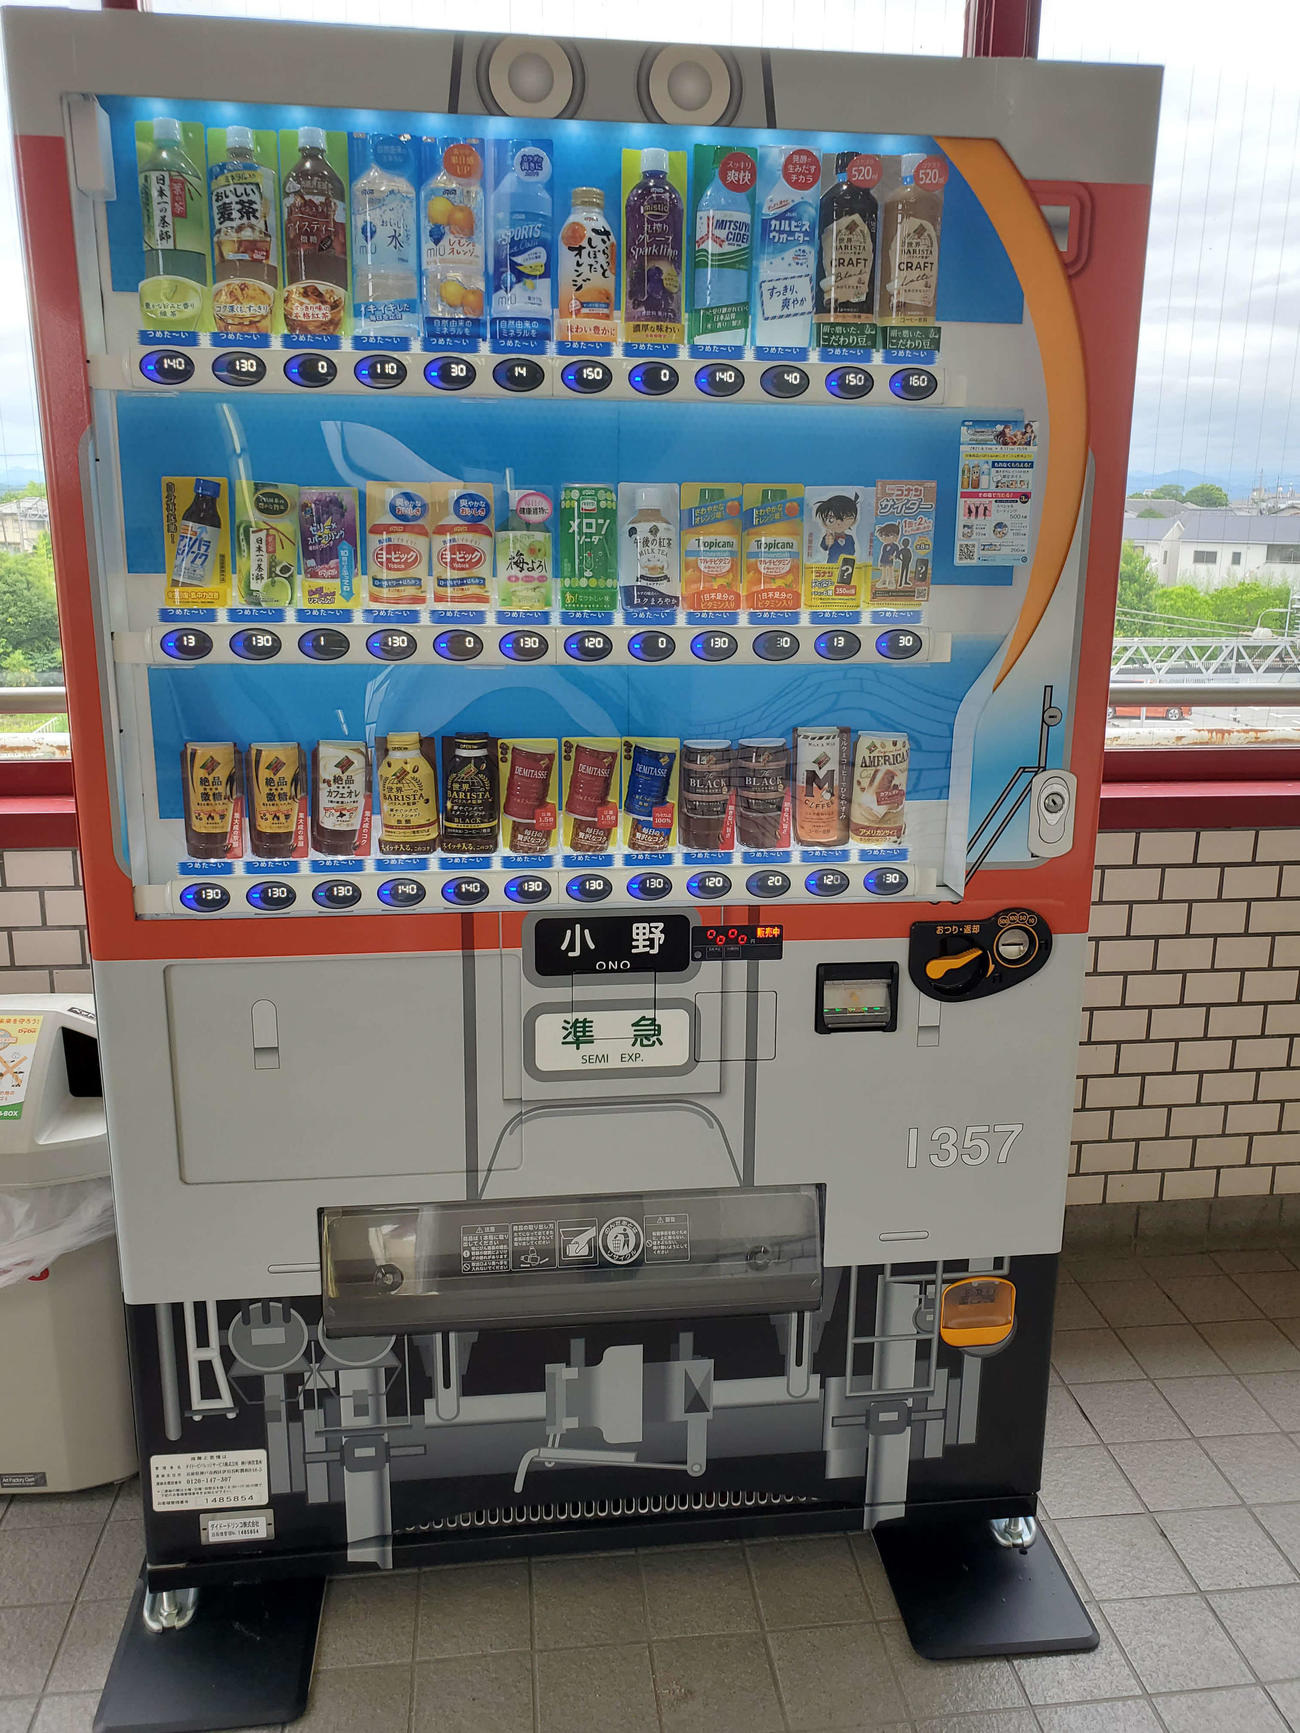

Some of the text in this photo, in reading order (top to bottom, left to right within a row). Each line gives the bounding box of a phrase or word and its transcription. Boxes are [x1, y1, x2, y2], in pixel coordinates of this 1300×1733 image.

[787, 164, 816, 174] 生みだす
[726, 170, 751, 185] 爽快
[791, 174, 813, 183] チカラ
[215, 187, 256, 203] おいしい
[156, 174, 171, 244] 日本一の茶師
[216, 199, 259, 225] 麦茶
[287, 220, 335, 235] アイスティー
[770, 219, 810, 232] カルピス
[387, 229, 404, 250] 水
[769, 231, 810, 244] ウォーター
[586, 236, 601, 273] しぼった
[591, 226, 612, 279] さらっと
[567, 244, 592, 292] オレンジ
[830, 258, 869, 269] CRAFT
[897, 261, 935, 272] CRAFT
[780, 297, 807, 312] 爽やか
[433, 319, 472, 328] 自然由来の
[499, 320, 539, 330] 自然由来の
[632, 324, 680, 334] 濃厚な味わい
[434, 329, 471, 337] ミネラルを
[501, 330, 537, 338] ミネラルを
[566, 325, 616, 337] 味わい豊かに
[163, 358, 184, 369] 140
[235, 360, 256, 371] 130
[317, 361, 327, 373] 0
[450, 365, 466, 376] 30
[514, 367, 526, 376] 14
[582, 368, 602, 379] 150
[660, 370, 669, 381] 0
[715, 371, 734, 382] 140
[783, 373, 799, 384] 40
[845, 374, 864, 385] 150
[909, 376, 927, 386] 160
[894, 486, 922, 498] コナン
[395, 507, 421, 517] おいしさ
[459, 507, 486, 516] おいしさ
[879, 497, 935, 516] サイダー
[568, 518, 611, 535] メロン
[633, 535, 672, 549] 午後の紅茶
[255, 536, 265, 584] 日本一の茶師
[377, 549, 417, 564] ヨービック
[442, 550, 481, 564] ヨービック
[698, 557, 730, 567] マルチビタミン
[758, 559, 791, 568] マルチビタミン
[814, 569, 834, 578] コナン
[633, 596, 678, 605] コクまろやか
[700, 592, 735, 601] 1日不足分の
[759, 591, 793, 600] 1日不足分の
[701, 600, 735, 610] ビタミン入り
[759, 600, 793, 609] ビタミン入り
[183, 636, 195, 646] 13
[252, 636, 272, 646] 130
[320, 637, 324, 645] 1
[387, 636, 407, 647] 130
[465, 637, 473, 647] 0
[520, 638, 538, 648] 130
[584, 638, 603, 648] 120
[658, 638, 666, 648] 0
[710, 638, 728, 648] 130
[833, 637, 844, 647] 13
[898, 636, 912, 646] 30
[199, 776, 222, 787] 絶品
[264, 776, 287, 787] 絶品
[332, 774, 355, 786] 絶品
[689, 778, 727, 789] BLACK
[745, 776, 783, 786] BLACK
[326, 788, 360, 799] カフェオレ
[448, 790, 490, 800] BARISTA
[454, 816, 481, 824] BLACK
[585, 880, 603, 889] 130
[646, 879, 663, 888] 130
[705, 877, 723, 886] 120
[767, 876, 782, 885] 20
[333, 886, 352, 896] 130
[397, 885, 416, 894] 140
[461, 883, 480, 892] 140
[522, 882, 542, 891] 130
[202, 889, 221, 899] 130
[268, 888, 286, 897] 130
[756, 926, 780, 939] 販売中
[935, 924, 980, 935] おつり・返却
[596, 960, 631, 971] ONO
[581, 1052, 644, 1065] SEMI EXP.
[906, 1122, 1024, 1169] 1357
[607, 1249, 637, 1261] リサイクル
